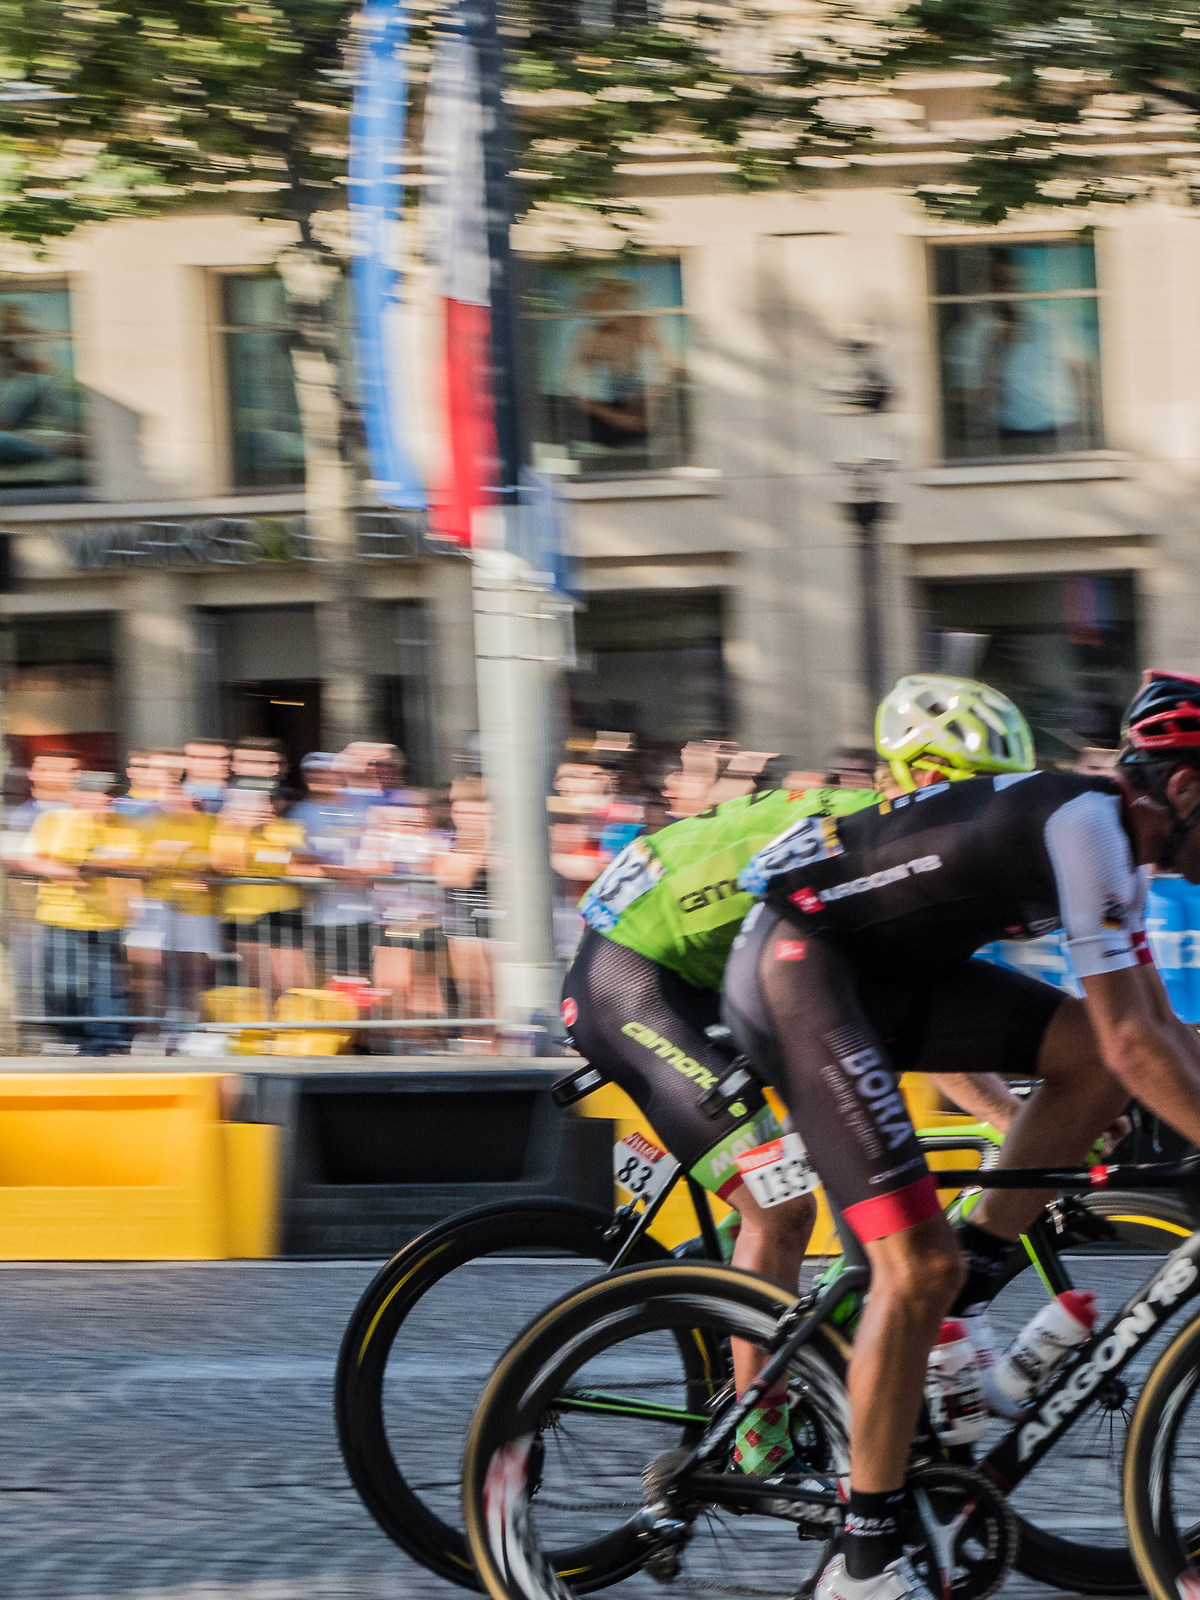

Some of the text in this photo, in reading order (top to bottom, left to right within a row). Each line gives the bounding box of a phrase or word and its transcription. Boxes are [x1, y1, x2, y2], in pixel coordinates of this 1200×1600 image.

[840, 1047, 915, 1151] BORA
[617, 1156, 653, 1193] 83
[1017, 1301, 1158, 1463] ARGON
